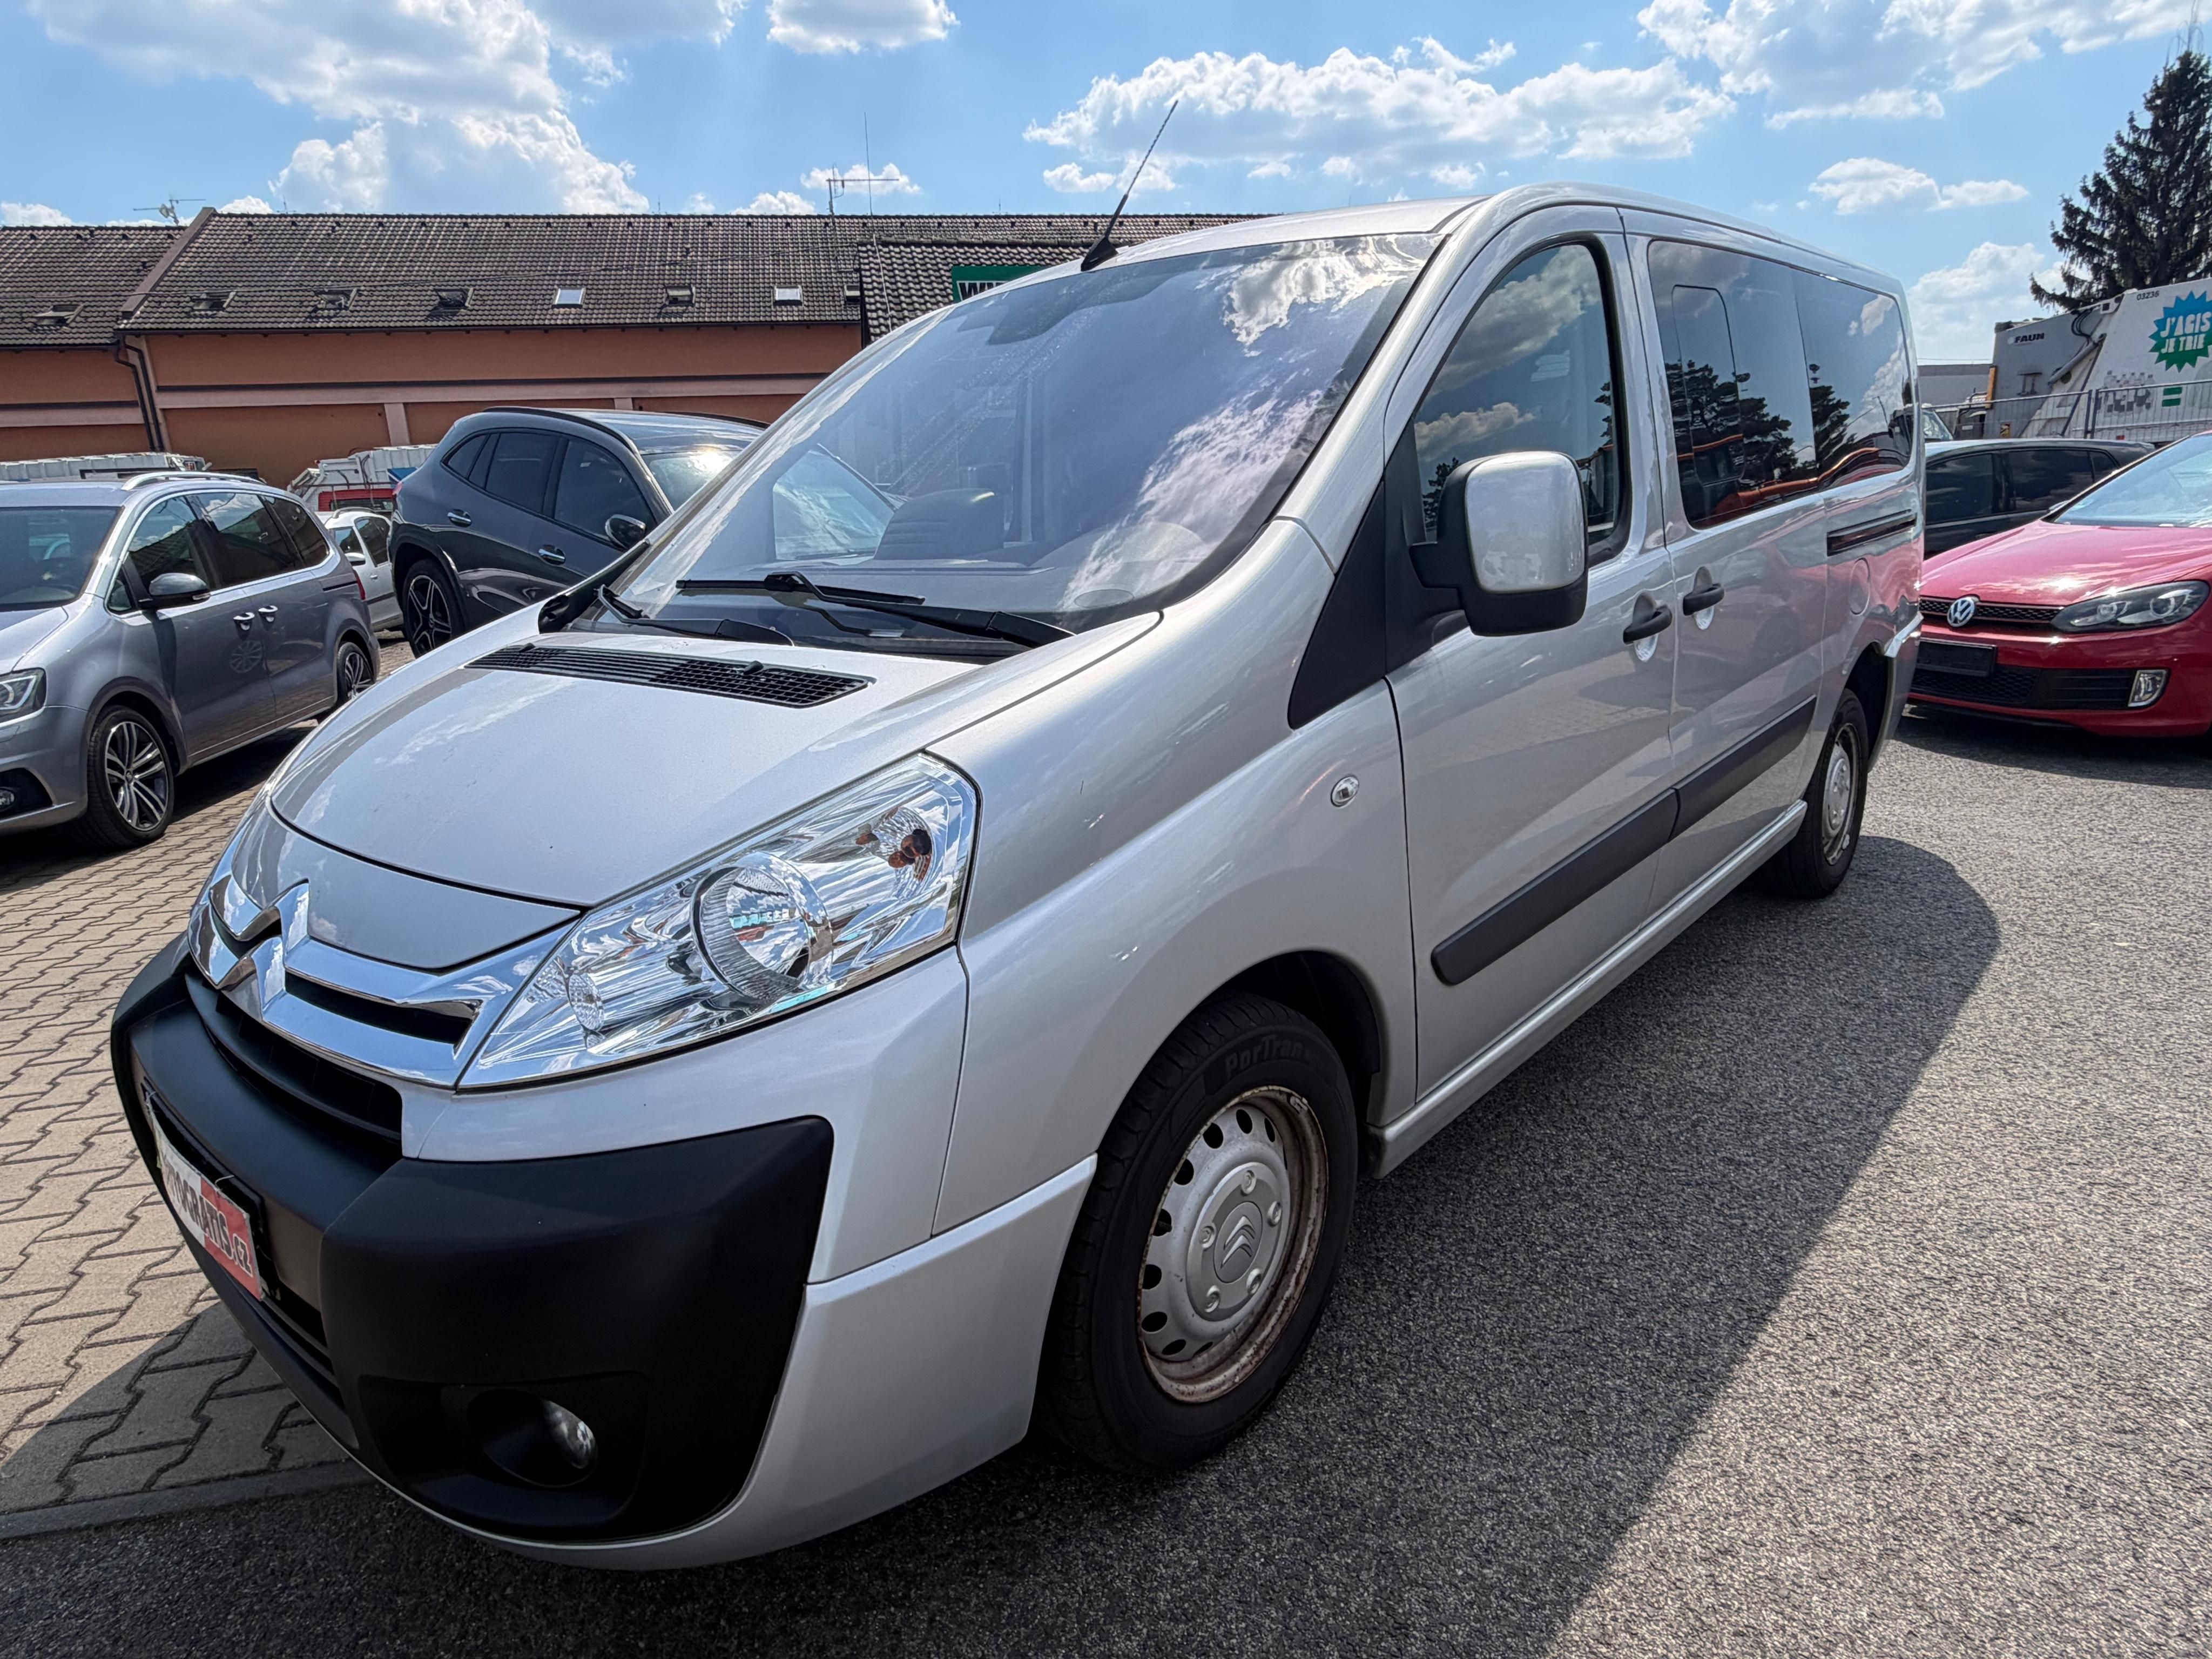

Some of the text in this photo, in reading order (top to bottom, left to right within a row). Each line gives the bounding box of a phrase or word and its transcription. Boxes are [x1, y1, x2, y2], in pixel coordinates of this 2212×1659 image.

[2160, 311, 2211, 338] J'AGIS
[2014, 333, 2045, 343] FAUN
[2161, 333, 2206, 354] JE TRIE
[1225, 1034, 1304, 1081] PorTran
